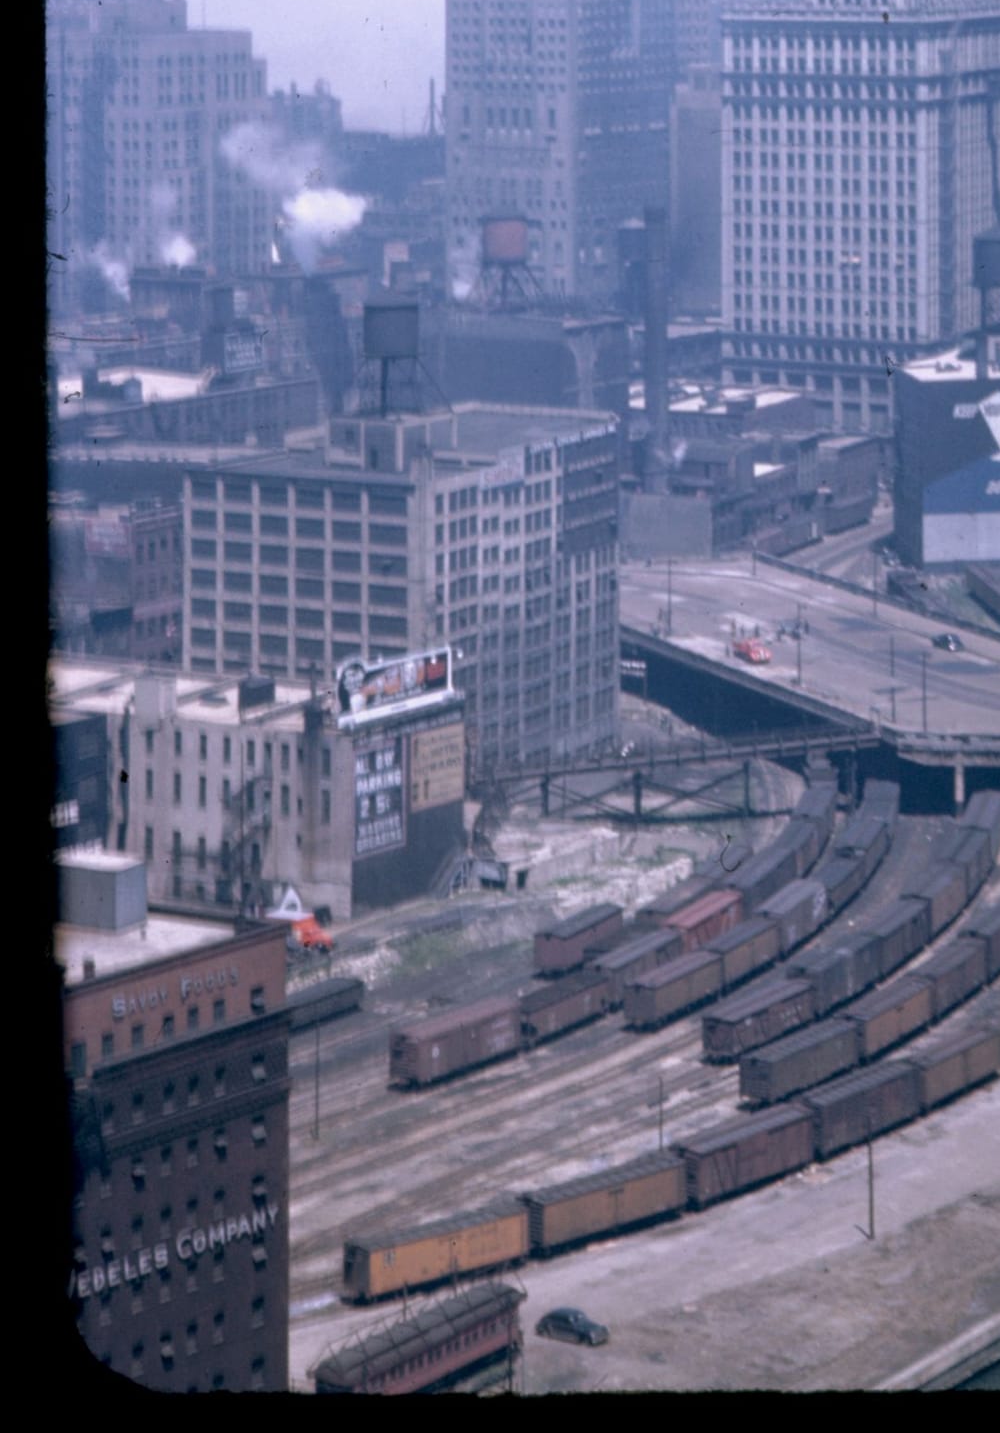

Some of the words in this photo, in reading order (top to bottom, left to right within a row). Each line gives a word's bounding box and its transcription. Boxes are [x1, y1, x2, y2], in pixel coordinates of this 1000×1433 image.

[356, 768, 402, 797] PARKING
[112, 982, 168, 1018] SAVOY
[180, 966, 239, 1001] FOODS
[176, 1204, 279, 1260] COMPANY
